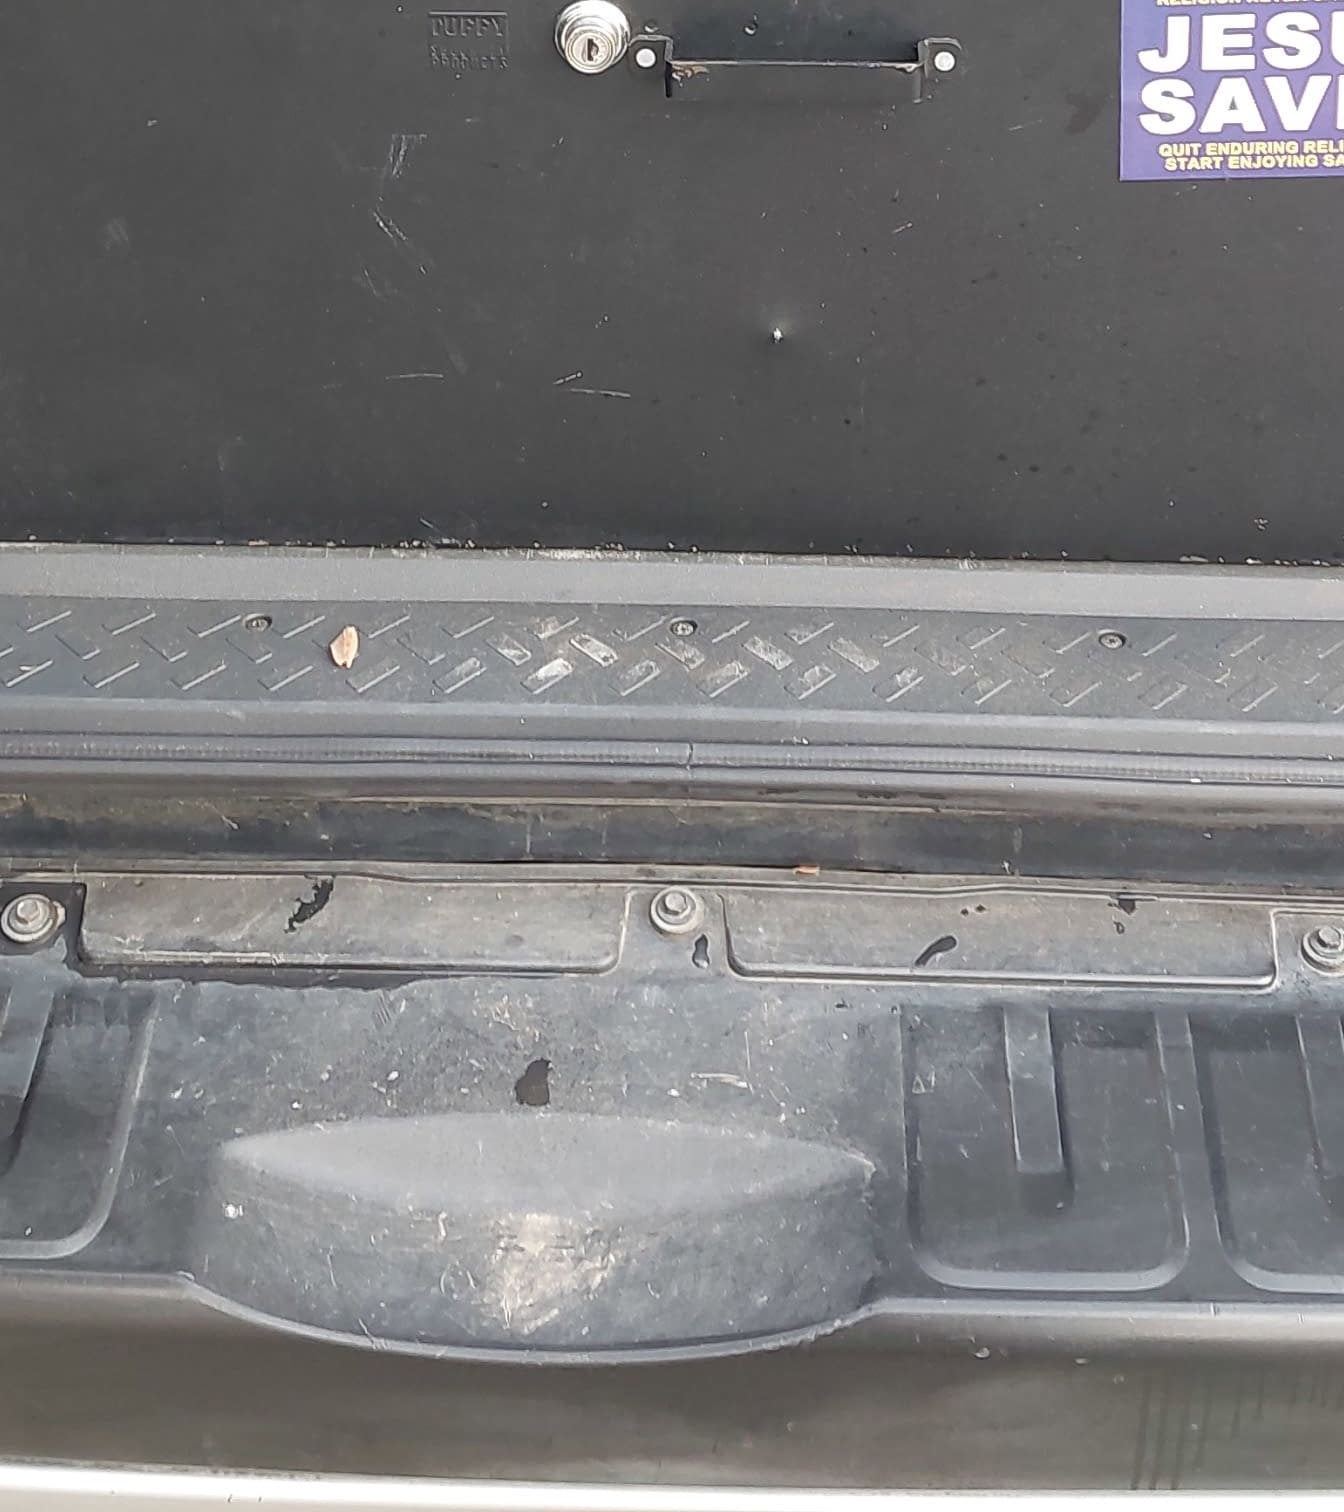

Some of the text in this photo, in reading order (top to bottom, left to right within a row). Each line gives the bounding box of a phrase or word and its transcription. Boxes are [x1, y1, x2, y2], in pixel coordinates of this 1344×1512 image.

[1158, 143, 1202, 157] QUIT
[1205, 141, 1299, 156] ENDURING
[1164, 156, 1224, 171] START
[1227, 154, 1319, 170] ENJOYING
